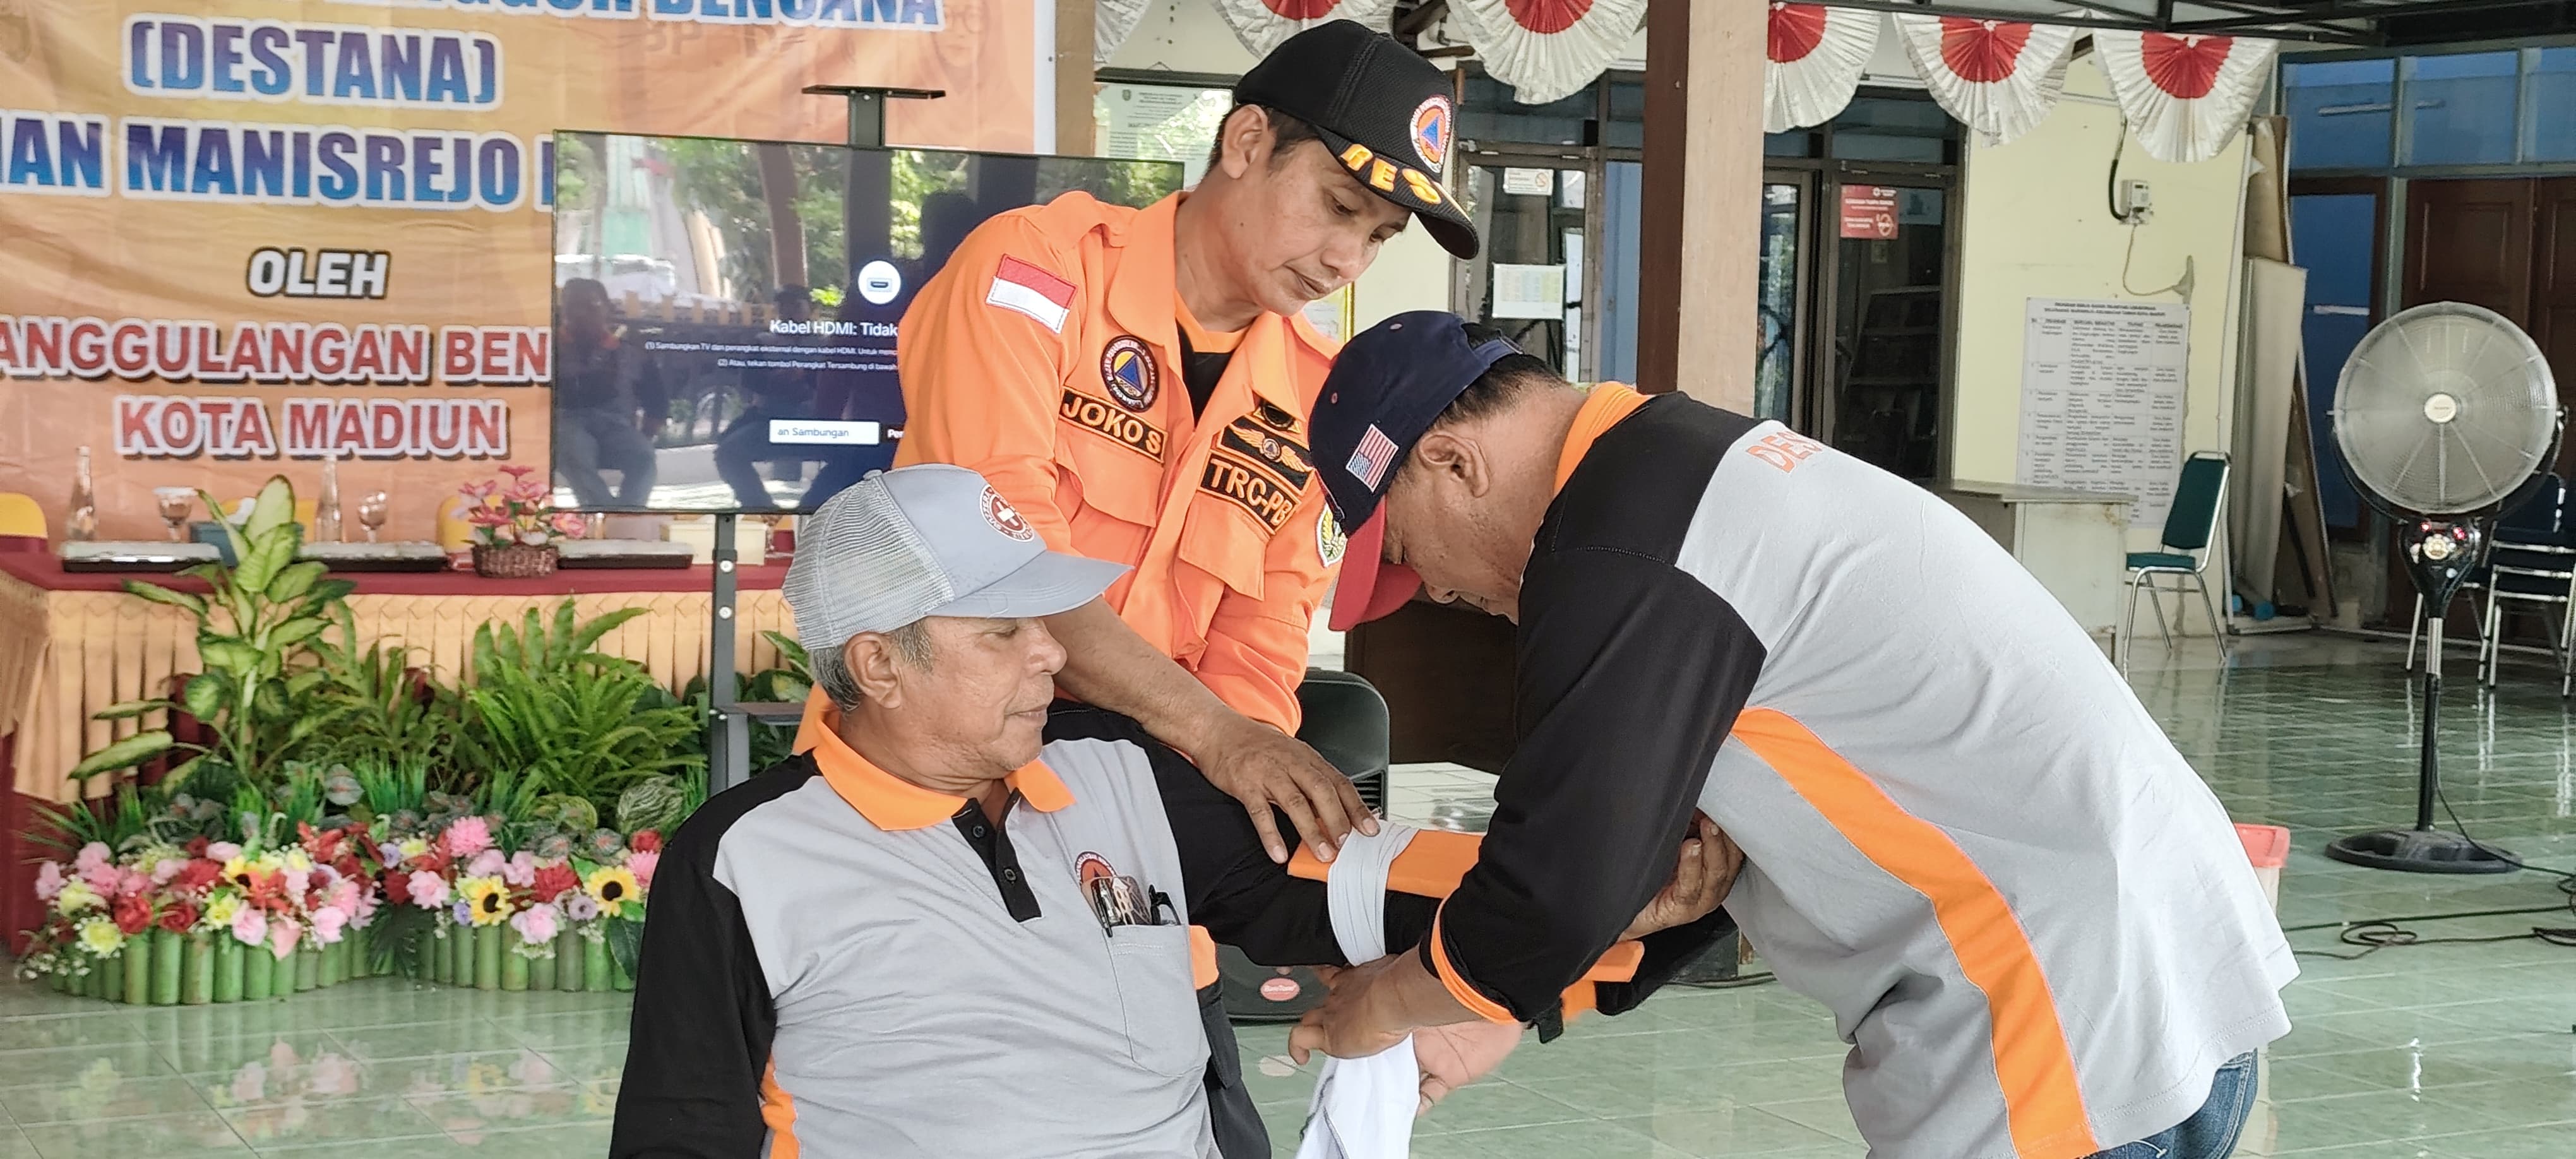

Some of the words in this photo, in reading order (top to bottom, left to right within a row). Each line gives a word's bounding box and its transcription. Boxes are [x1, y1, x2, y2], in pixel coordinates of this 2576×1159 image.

[131, 21, 495, 104] (DESTANA)
[0, 116, 104, 188] AN
[128, 123, 520, 205] MANISREJO
[247, 249, 390, 298] OLEH
[770, 319, 810, 335] Kabel
[813, 321, 857, 336] HDMI:
[121, 401, 269, 449] KOTA
[289, 403, 501, 450] MADIUN
[792, 427, 849, 439] Sambungan
[1062, 397, 1143, 444] JOKO
[1145, 431, 1162, 455] S
[1210, 458, 1293, 526] TRC-PB
